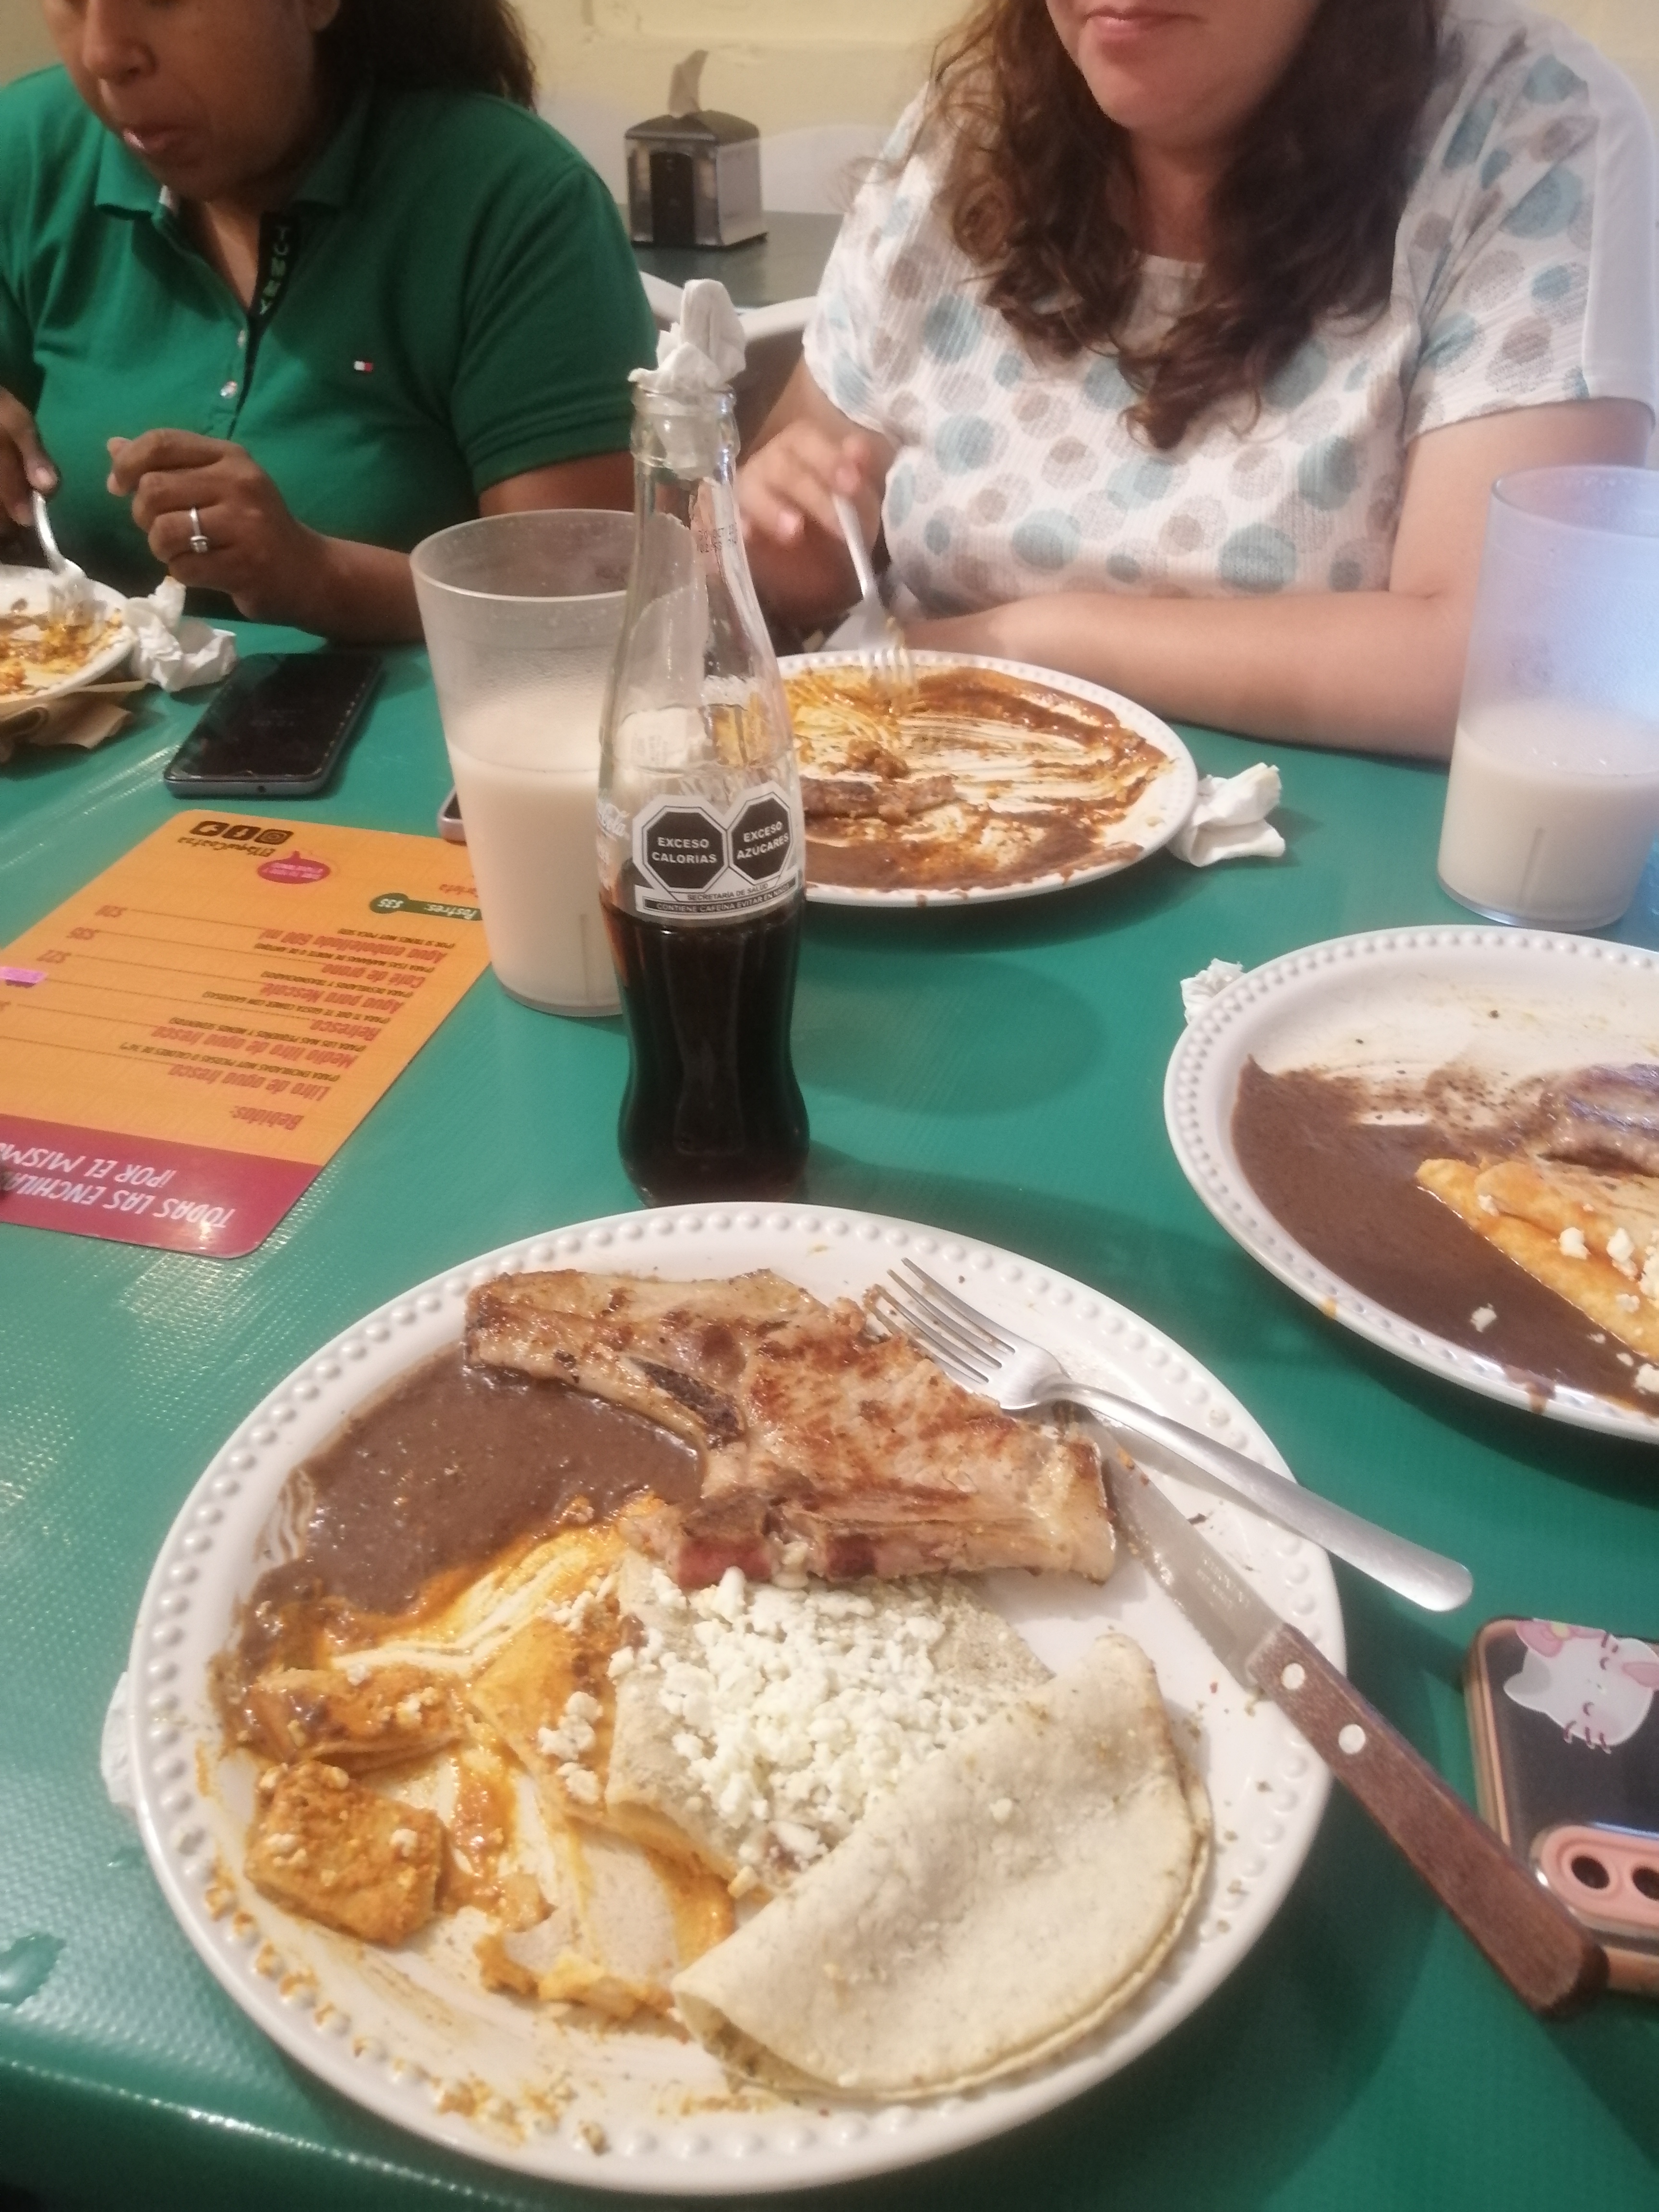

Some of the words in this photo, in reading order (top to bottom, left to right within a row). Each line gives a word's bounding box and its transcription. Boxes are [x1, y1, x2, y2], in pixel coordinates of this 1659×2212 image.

[743, 821, 783, 842] EXCESO
[657, 837, 709, 849] EXCESO
[747, 883, 769, 893] SALUD
[377, 898, 404, 909] $35
[423, 903, 477, 920] Postres:
[656, 902, 696, 912] CONTIENE
[737, 896, 763, 908] EVITAR
[366, 970, 388, 983] de
[245, 1041, 270, 1055] de
[266, 1080, 290, 1094] de
[84, 1158, 118, 1178] EL
[0, 1171, 107, 1205] ENCHILA
[102, 1190, 156, 1214] LAS
[152, 1198, 236, 1228] TODAS
